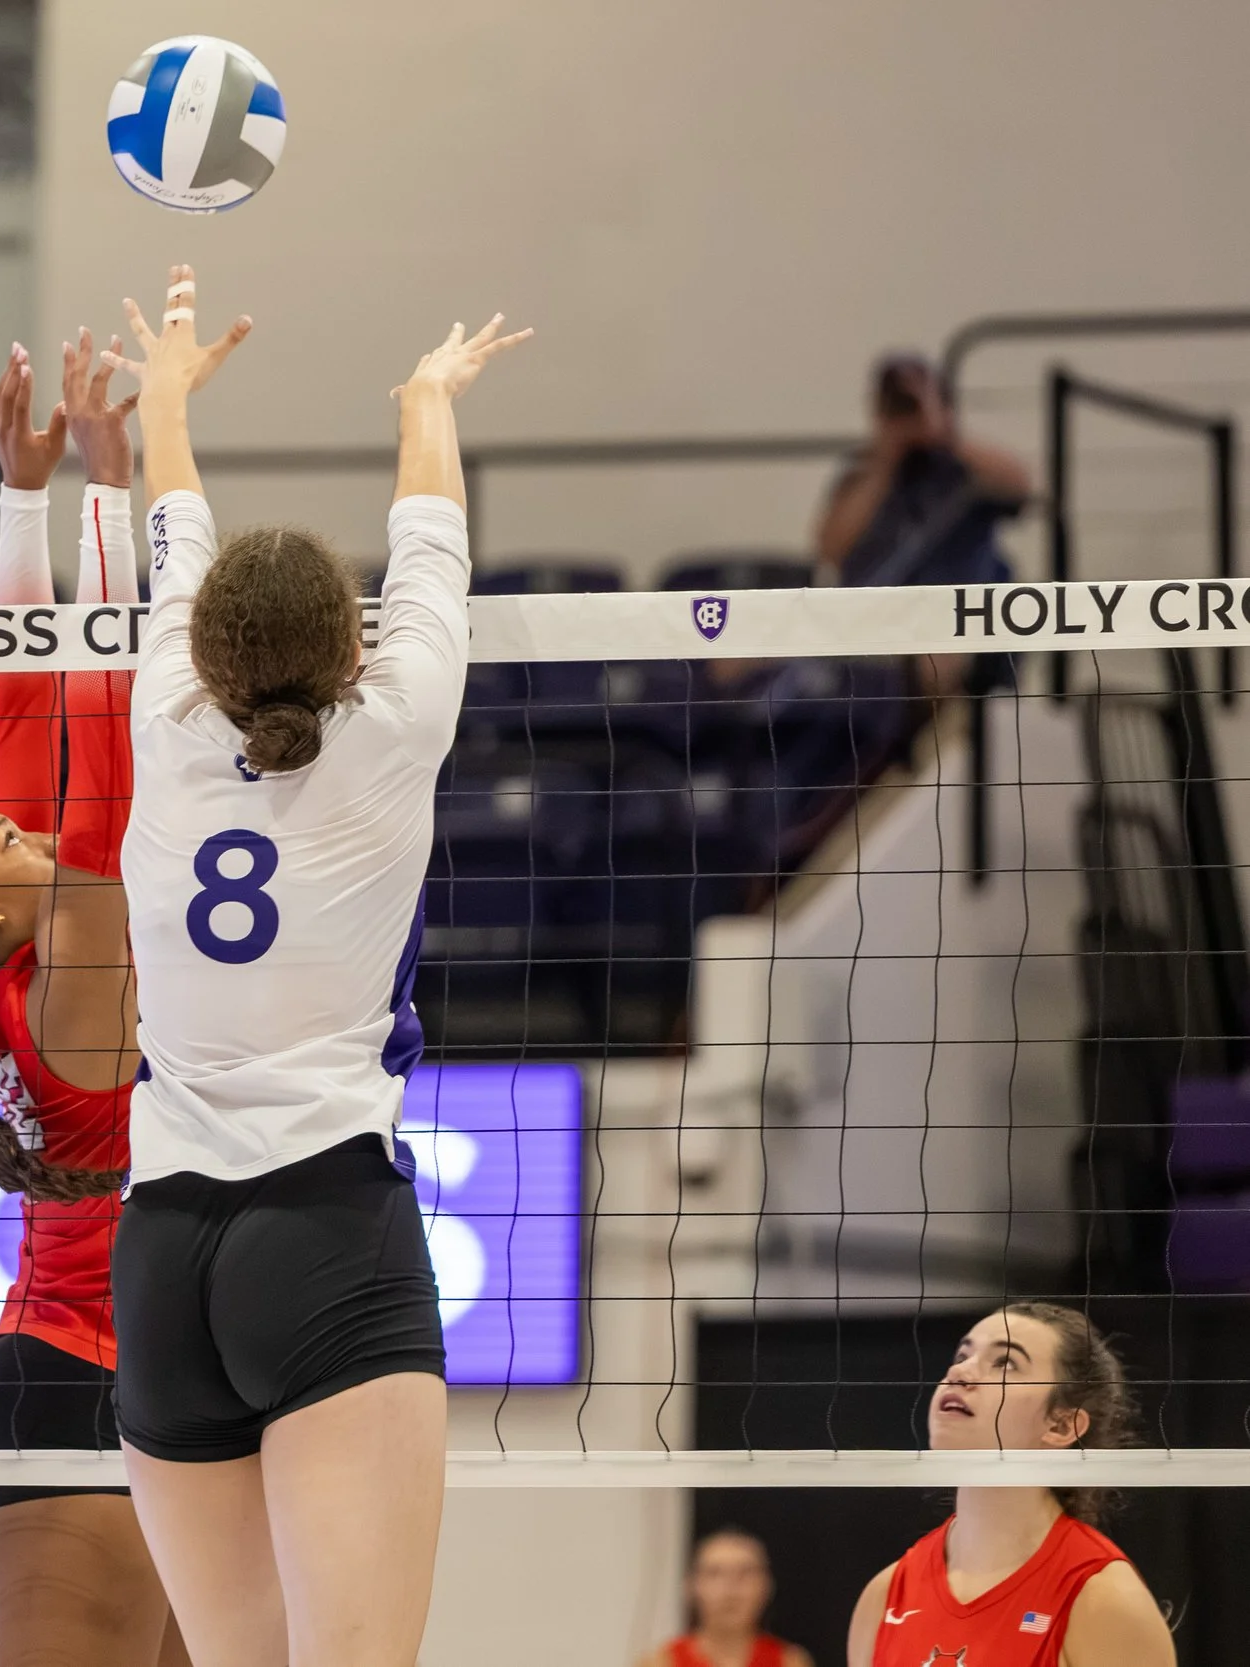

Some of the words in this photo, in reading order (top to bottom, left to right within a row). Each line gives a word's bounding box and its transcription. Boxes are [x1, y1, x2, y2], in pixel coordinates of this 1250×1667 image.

[953, 585, 1128, 637] HOLY
[1150, 581, 1250, 632] CR
[186, 828, 279, 965] 8
